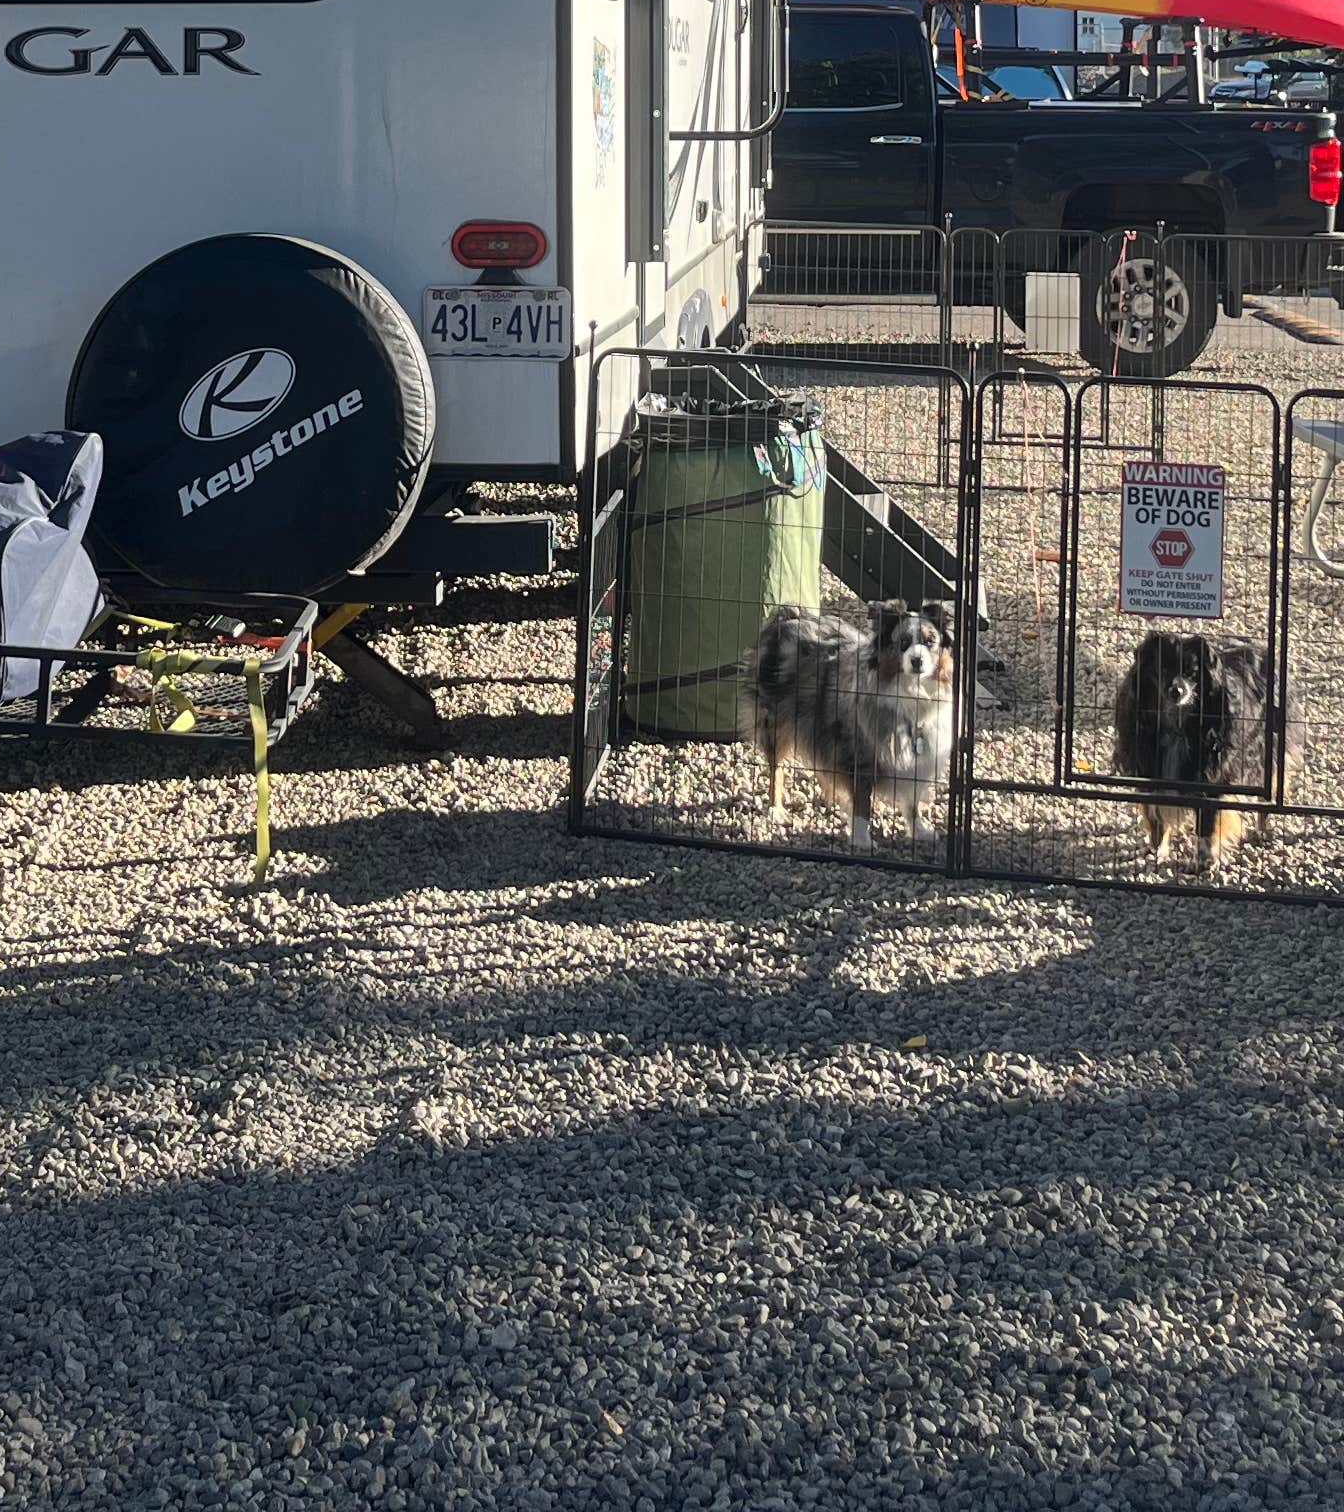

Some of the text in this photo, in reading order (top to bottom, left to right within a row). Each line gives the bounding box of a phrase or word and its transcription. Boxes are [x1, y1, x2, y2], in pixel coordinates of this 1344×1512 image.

[431, 304, 563, 343] 43L P 4VH
[178, 388, 364, 517] Keystone
[1124, 464, 1223, 486] WARNING
[1127, 486, 1220, 510] BEWARE
[1135, 507, 1211, 528] OF DOG
[1156, 540, 1188, 556] STOP
[1128, 568, 1214, 582] KEEP GATE SHUT
[1140, 579, 1201, 590] DO NOT ENTER
[1126, 588, 1217, 601] WITHOUT PERMISSION
[1129, 597, 1213, 610] OR OWNER PRESENT
